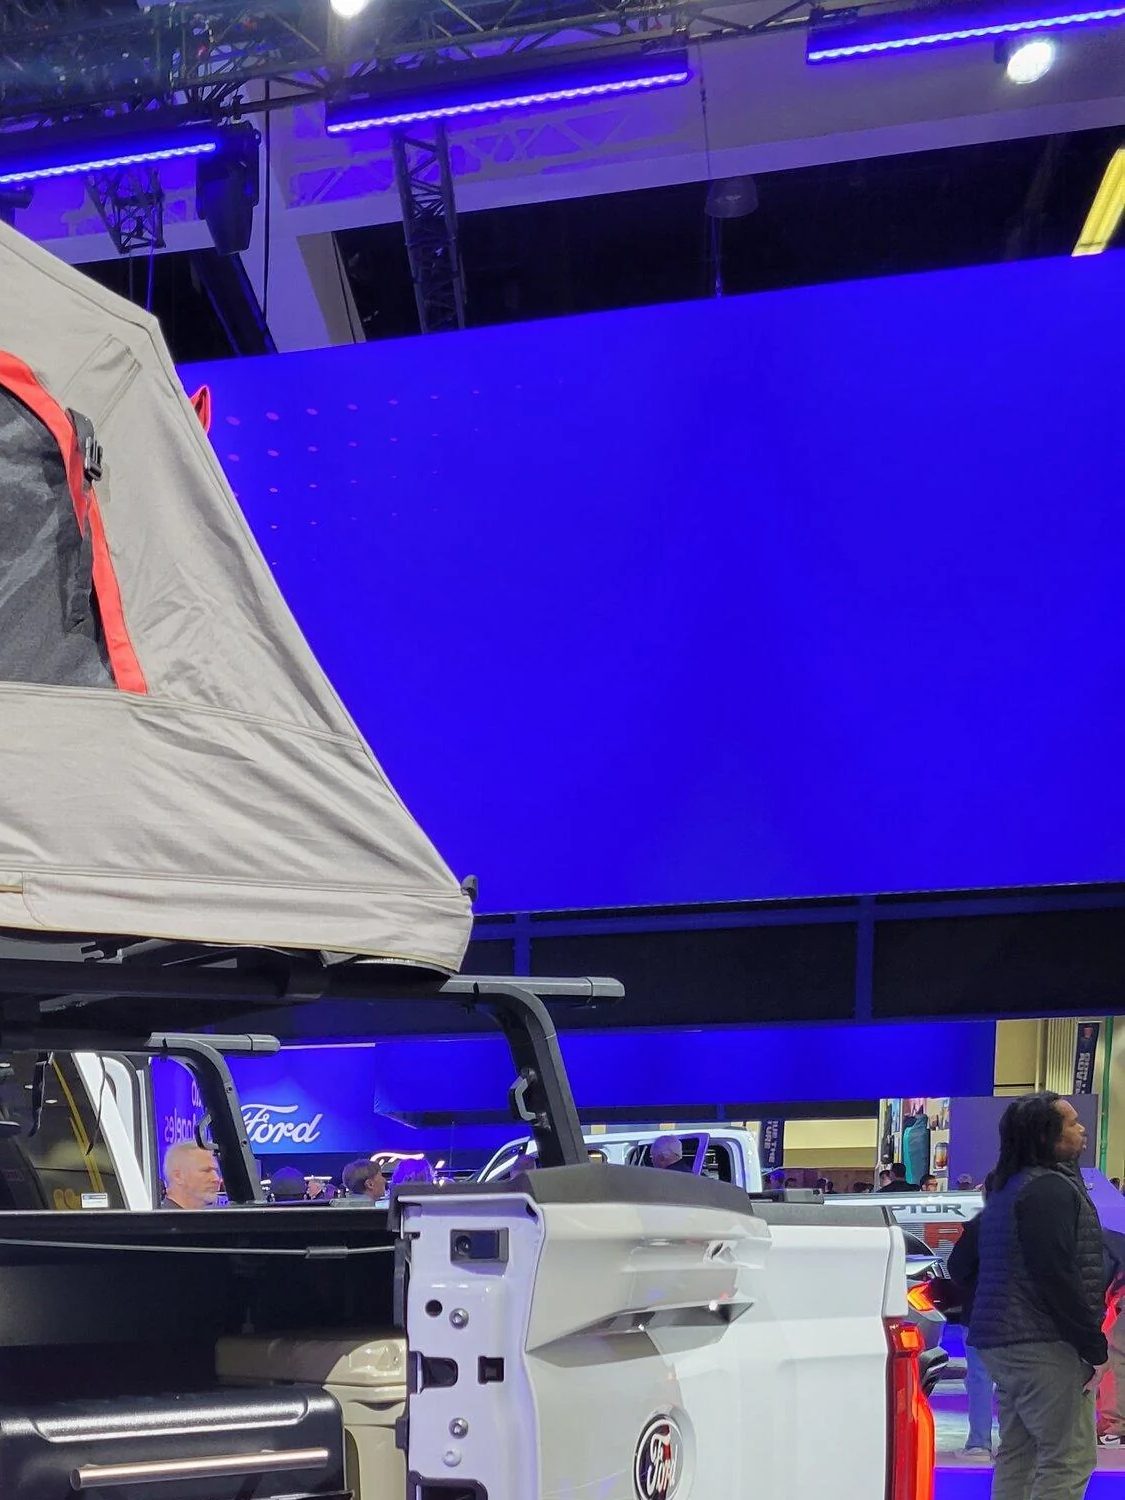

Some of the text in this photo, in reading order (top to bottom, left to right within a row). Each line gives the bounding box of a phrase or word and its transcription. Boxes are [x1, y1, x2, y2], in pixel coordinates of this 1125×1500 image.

[241, 1103, 323, 1143] Ford
[891, 1204, 967, 1217] PTOR
[645, 1432, 678, 1494] Ford
